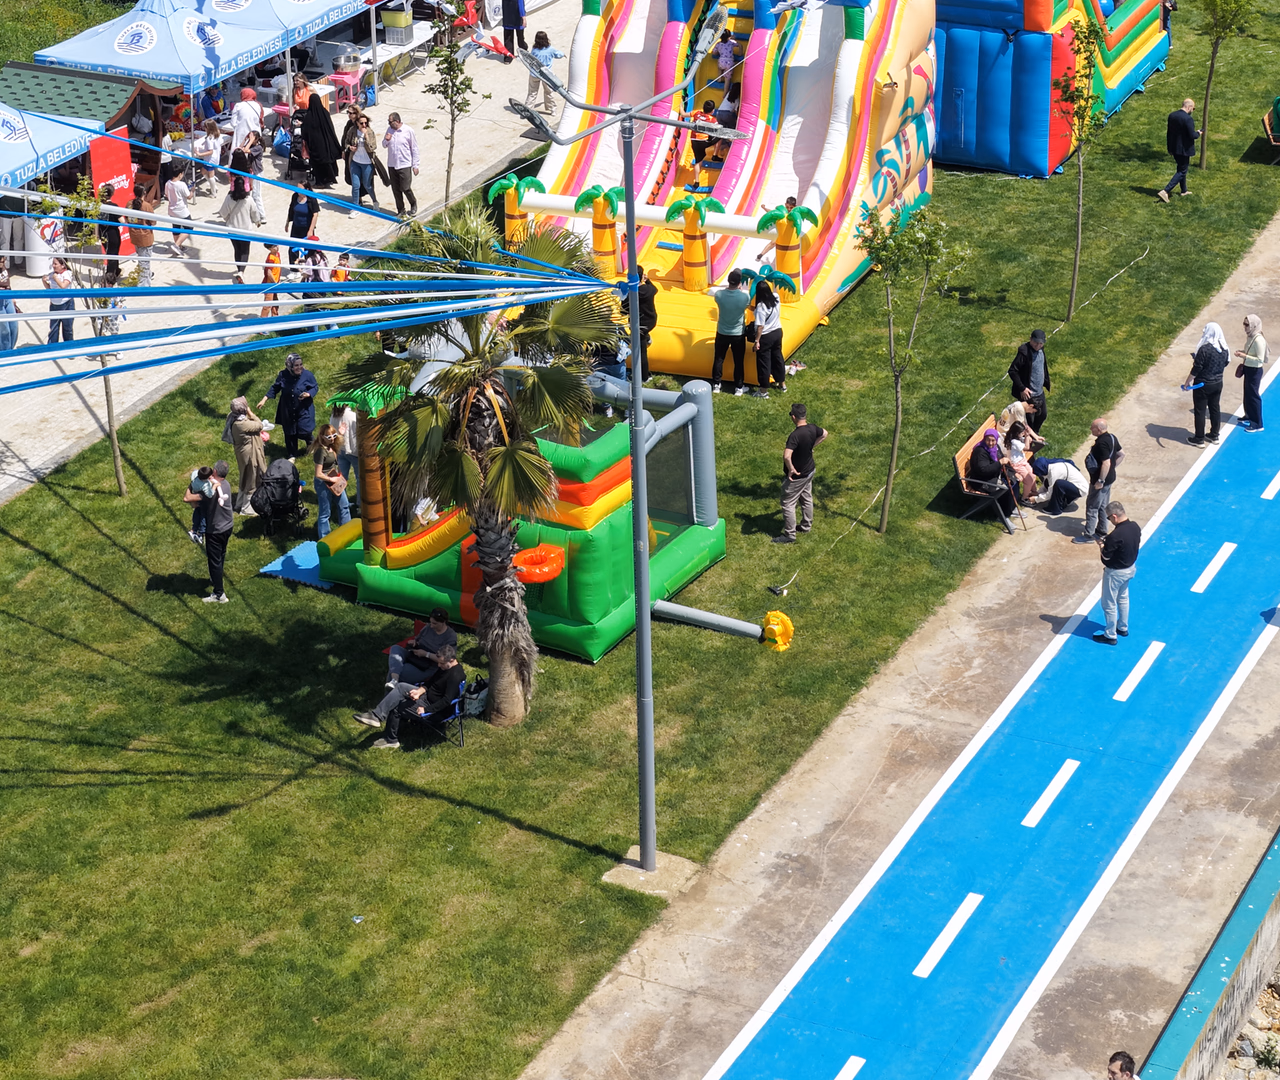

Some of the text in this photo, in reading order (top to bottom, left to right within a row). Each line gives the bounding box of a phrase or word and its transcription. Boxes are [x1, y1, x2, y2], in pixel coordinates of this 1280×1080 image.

[305, 15, 329, 35] TUZLA
[211, 34, 283, 81] TUZLA BELEDİYESİ
[14, 157, 47, 183] TUZLA
